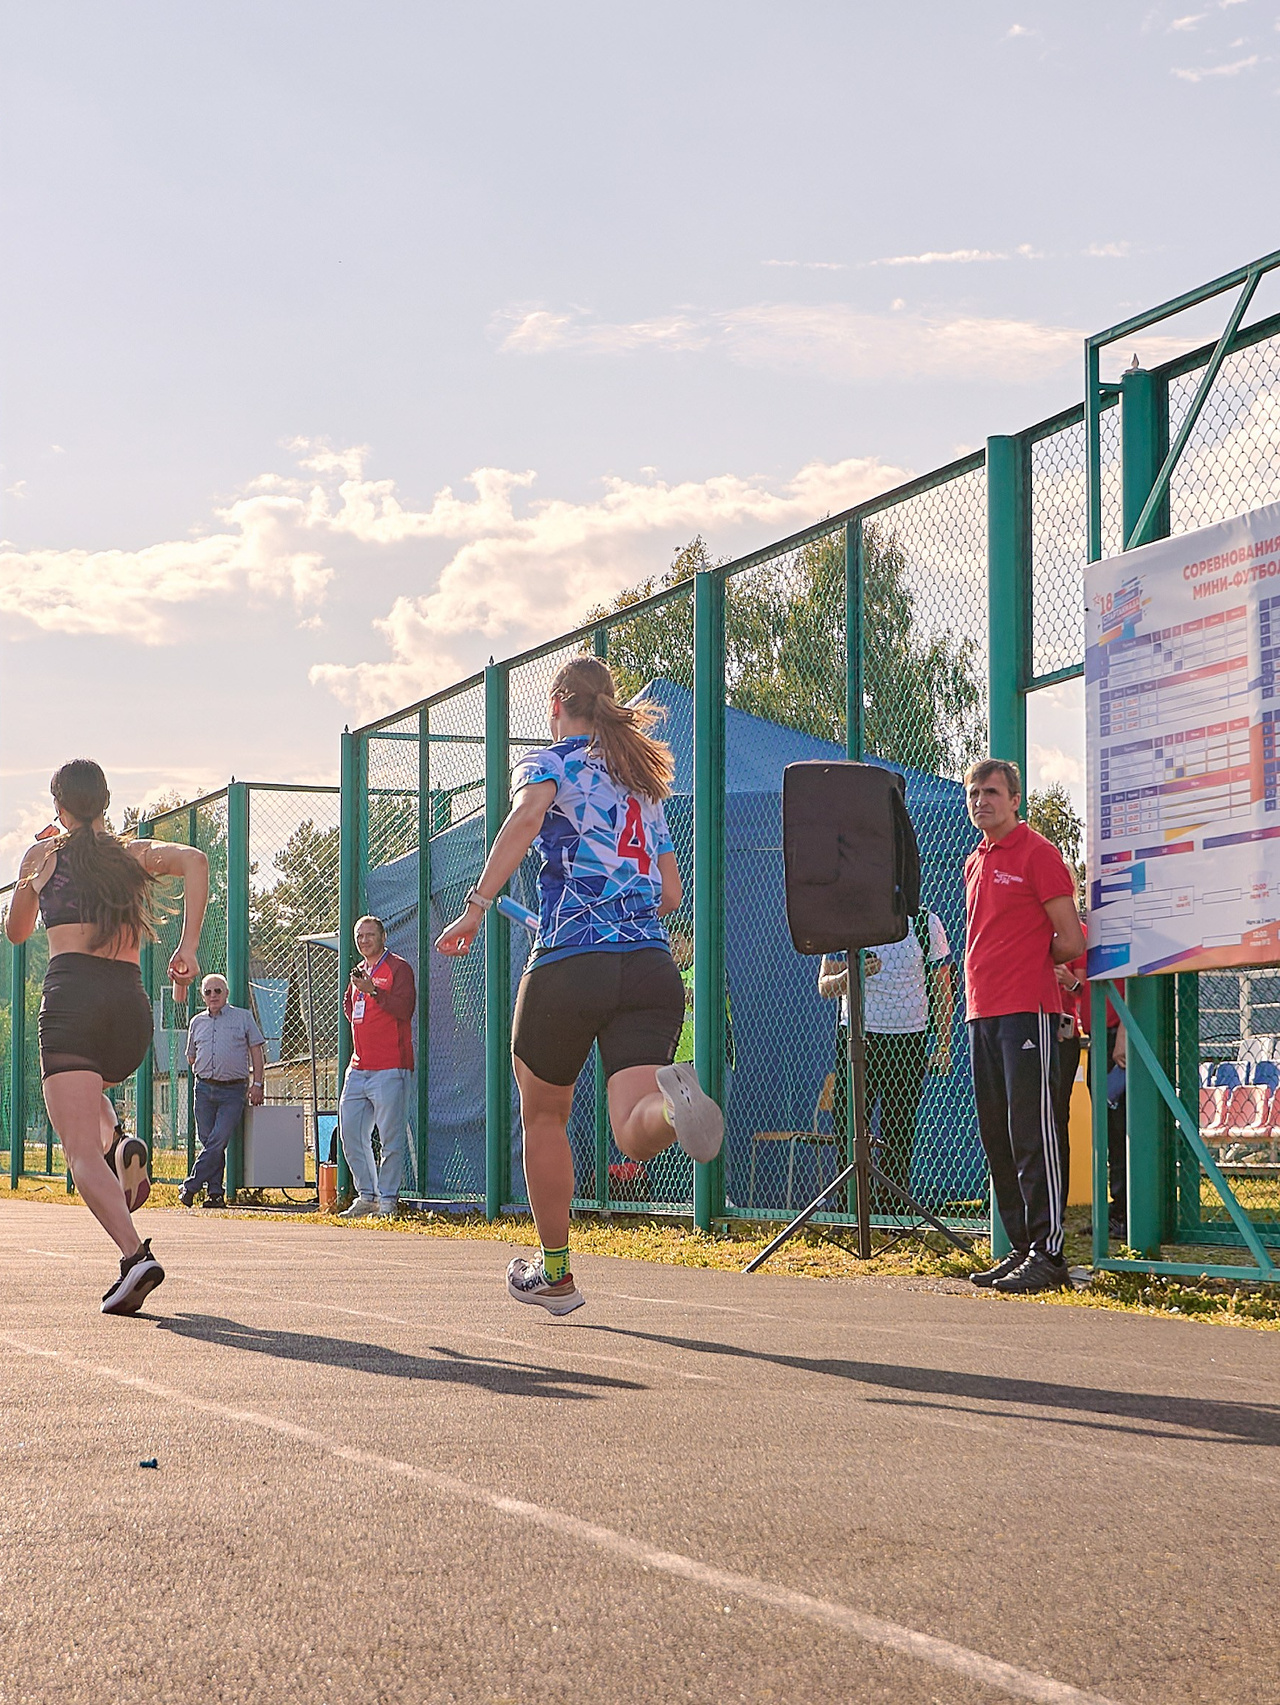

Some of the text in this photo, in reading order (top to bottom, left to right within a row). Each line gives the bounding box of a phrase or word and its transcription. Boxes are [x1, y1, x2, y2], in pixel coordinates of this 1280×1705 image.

[1183, 535, 1280, 580] СОРЕВНОВАНИЯ
[1100, 592, 1113, 615] 18
[618, 796, 651, 875] 4
[521, 1275, 543, 1292] HOKA
